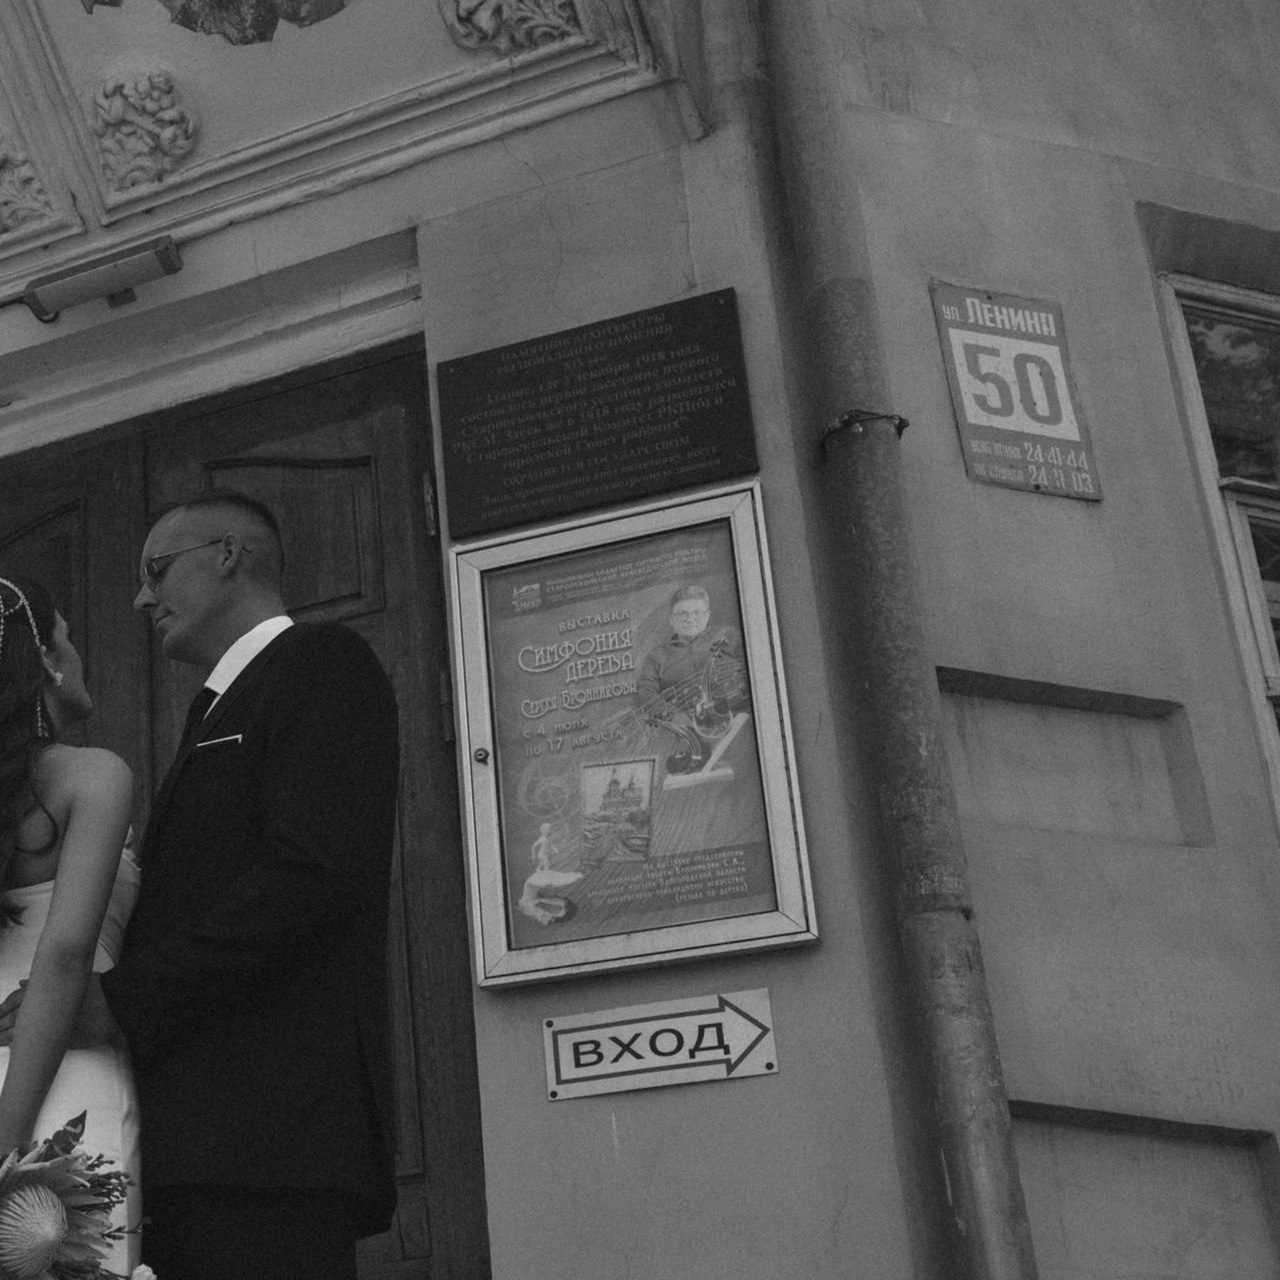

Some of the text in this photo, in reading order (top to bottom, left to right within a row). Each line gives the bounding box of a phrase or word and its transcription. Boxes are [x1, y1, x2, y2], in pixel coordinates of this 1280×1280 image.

[635, 351, 665, 366] 1918
[670, 344, 699, 358] года
[663, 354, 719, 375] первого
[655, 368, 722, 389] комитета
[962, 342, 1064, 426] 50
[580, 406, 609, 421] 1918
[614, 401, 642, 416] году
[593, 411, 650, 433] Комитет
[658, 396, 710, 419] РКП(б)
[714, 395, 723, 405] и
[576, 434, 615, 452] Совет
[558, 609, 629, 632] ВЫСТАВКА
[565, 651, 634, 684] ДЕРЕВА
[537, 723, 546, 736] 4
[548, 737, 563, 752] 17
[572, 1022, 731, 1069] ВХОД
